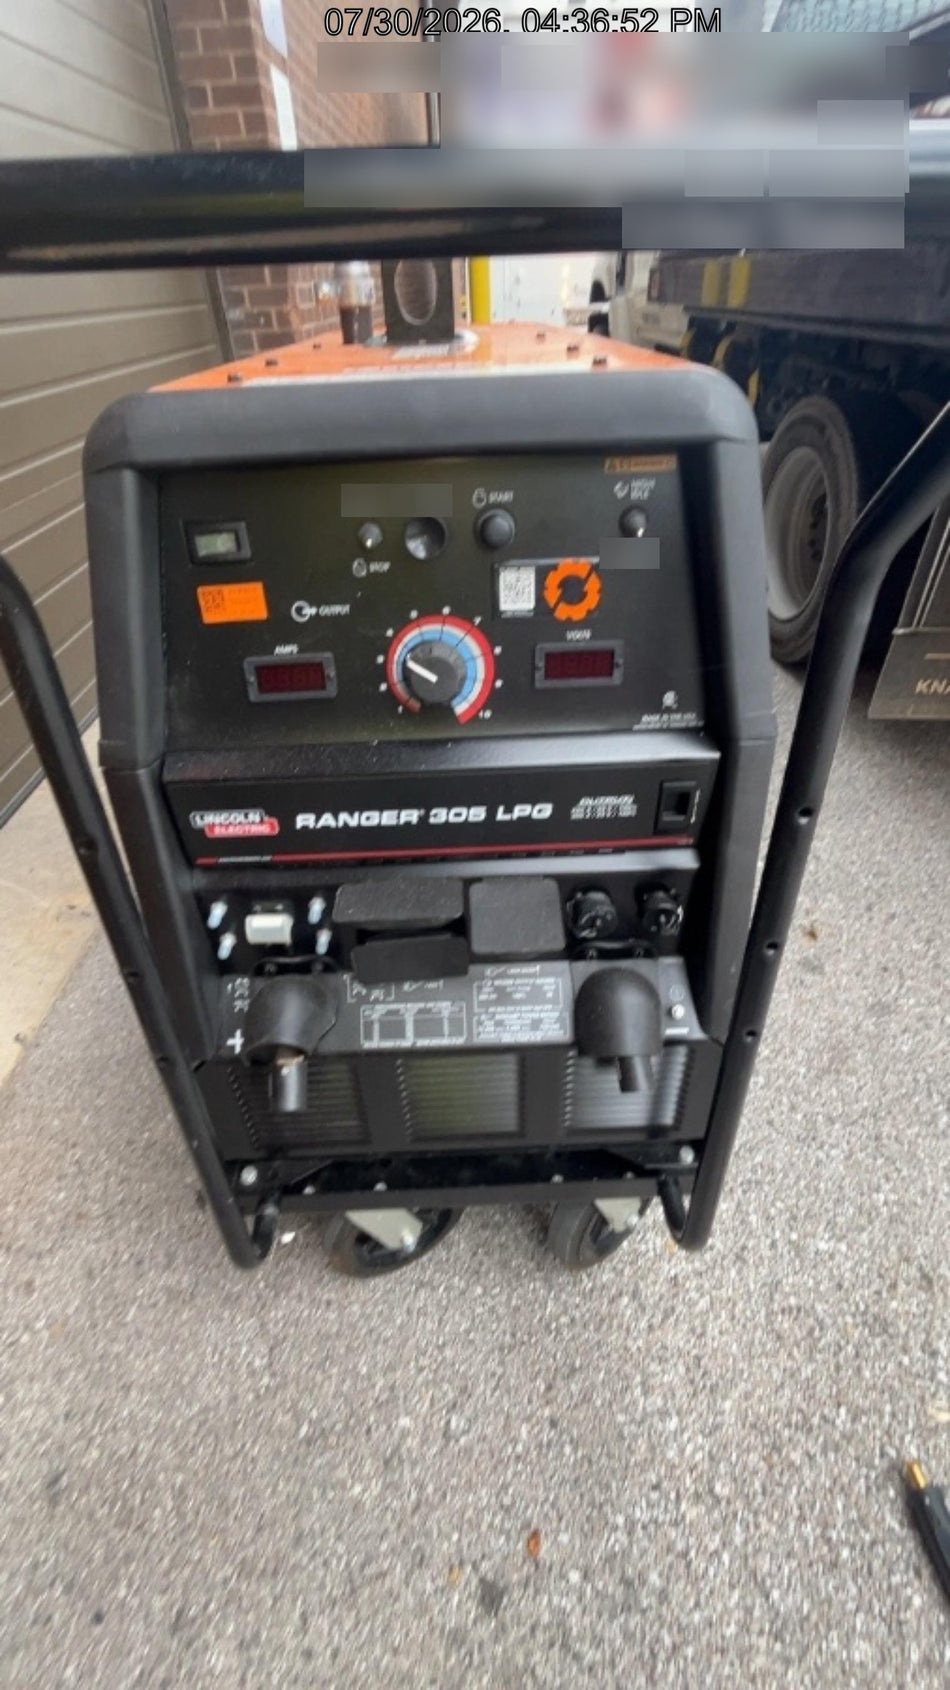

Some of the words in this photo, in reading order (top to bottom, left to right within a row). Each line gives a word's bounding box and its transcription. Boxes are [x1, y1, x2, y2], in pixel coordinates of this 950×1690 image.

[369, 561, 391, 573] STOP
[319, 604, 350, 616] OUTPUT
[194, 811, 262, 827] LINCOLN
[429, 805, 487, 824] 305
[496, 803, 553, 821] LPG
[213, 823, 271, 835] ELECTRIC
